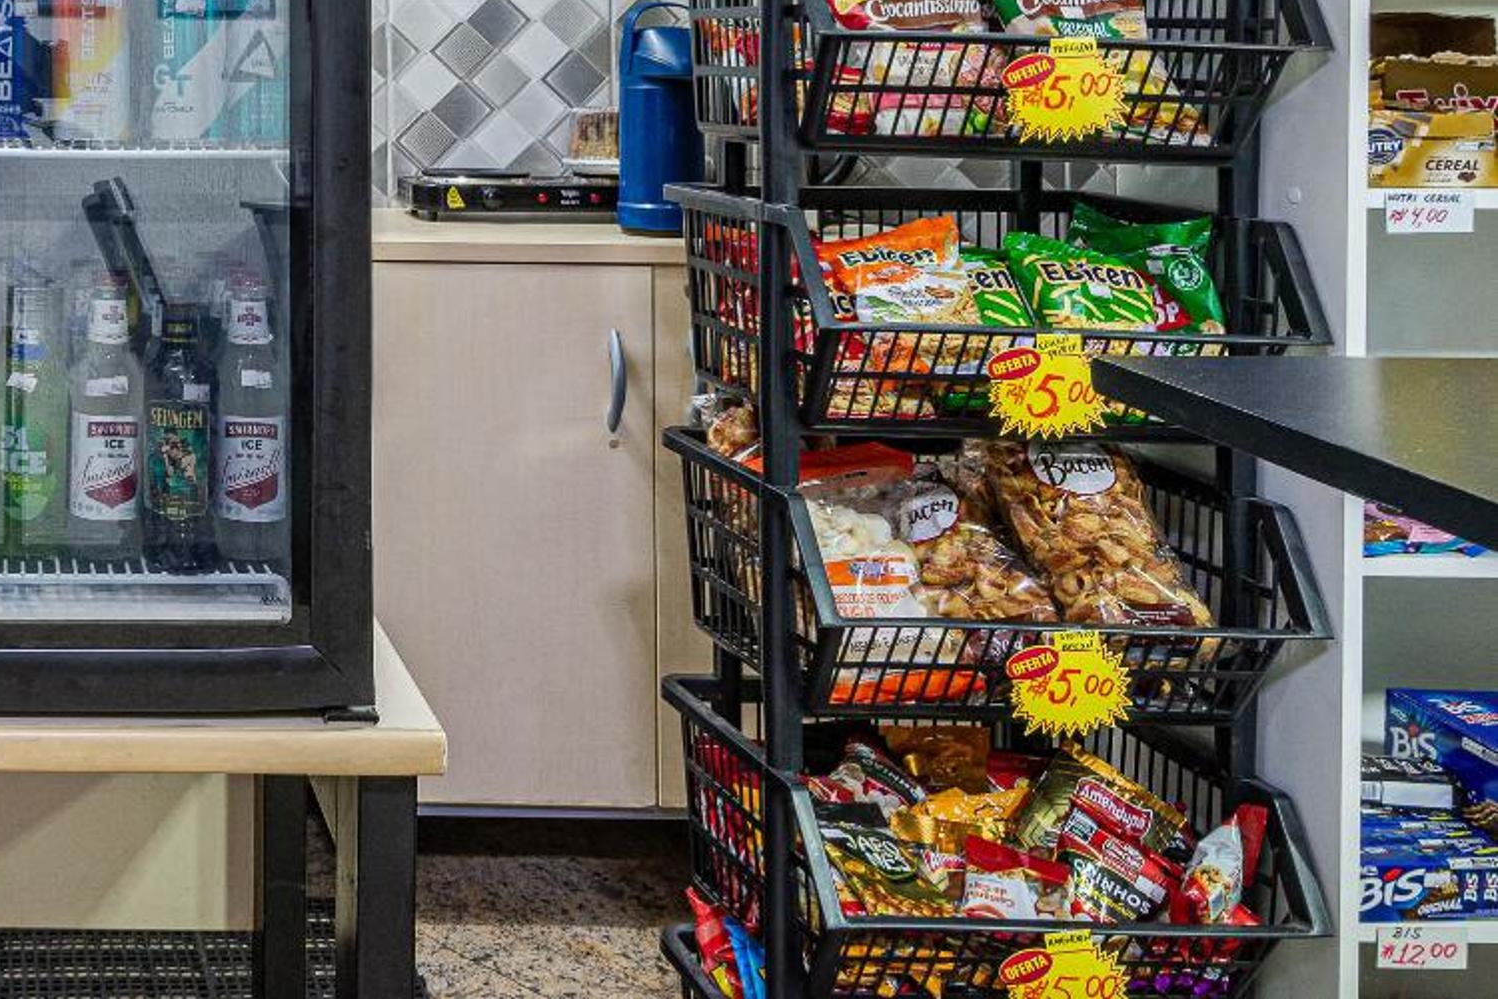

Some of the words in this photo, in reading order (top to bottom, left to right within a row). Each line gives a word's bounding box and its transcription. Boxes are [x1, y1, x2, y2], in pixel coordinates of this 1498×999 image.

[1007, 59, 1051, 84] OFERTA
[1043, 72, 1114, 112] 5,00
[1424, 159, 1480, 172] CEREAL
[1410, 207, 1449, 229] 4,00
[1039, 262, 1147, 290] Ebicen
[991, 354, 1037, 376] OFERTA
[103, 439, 126, 449] ICE
[240, 439, 264, 450] ICE
[0, 450, 47, 475] ICE
[1012, 651, 1056, 676] OFERTA
[1048, 668, 1116, 708] 5,00
[1392, 927, 1423, 939] BIS
[1003, 954, 1049, 980] OFERTA
